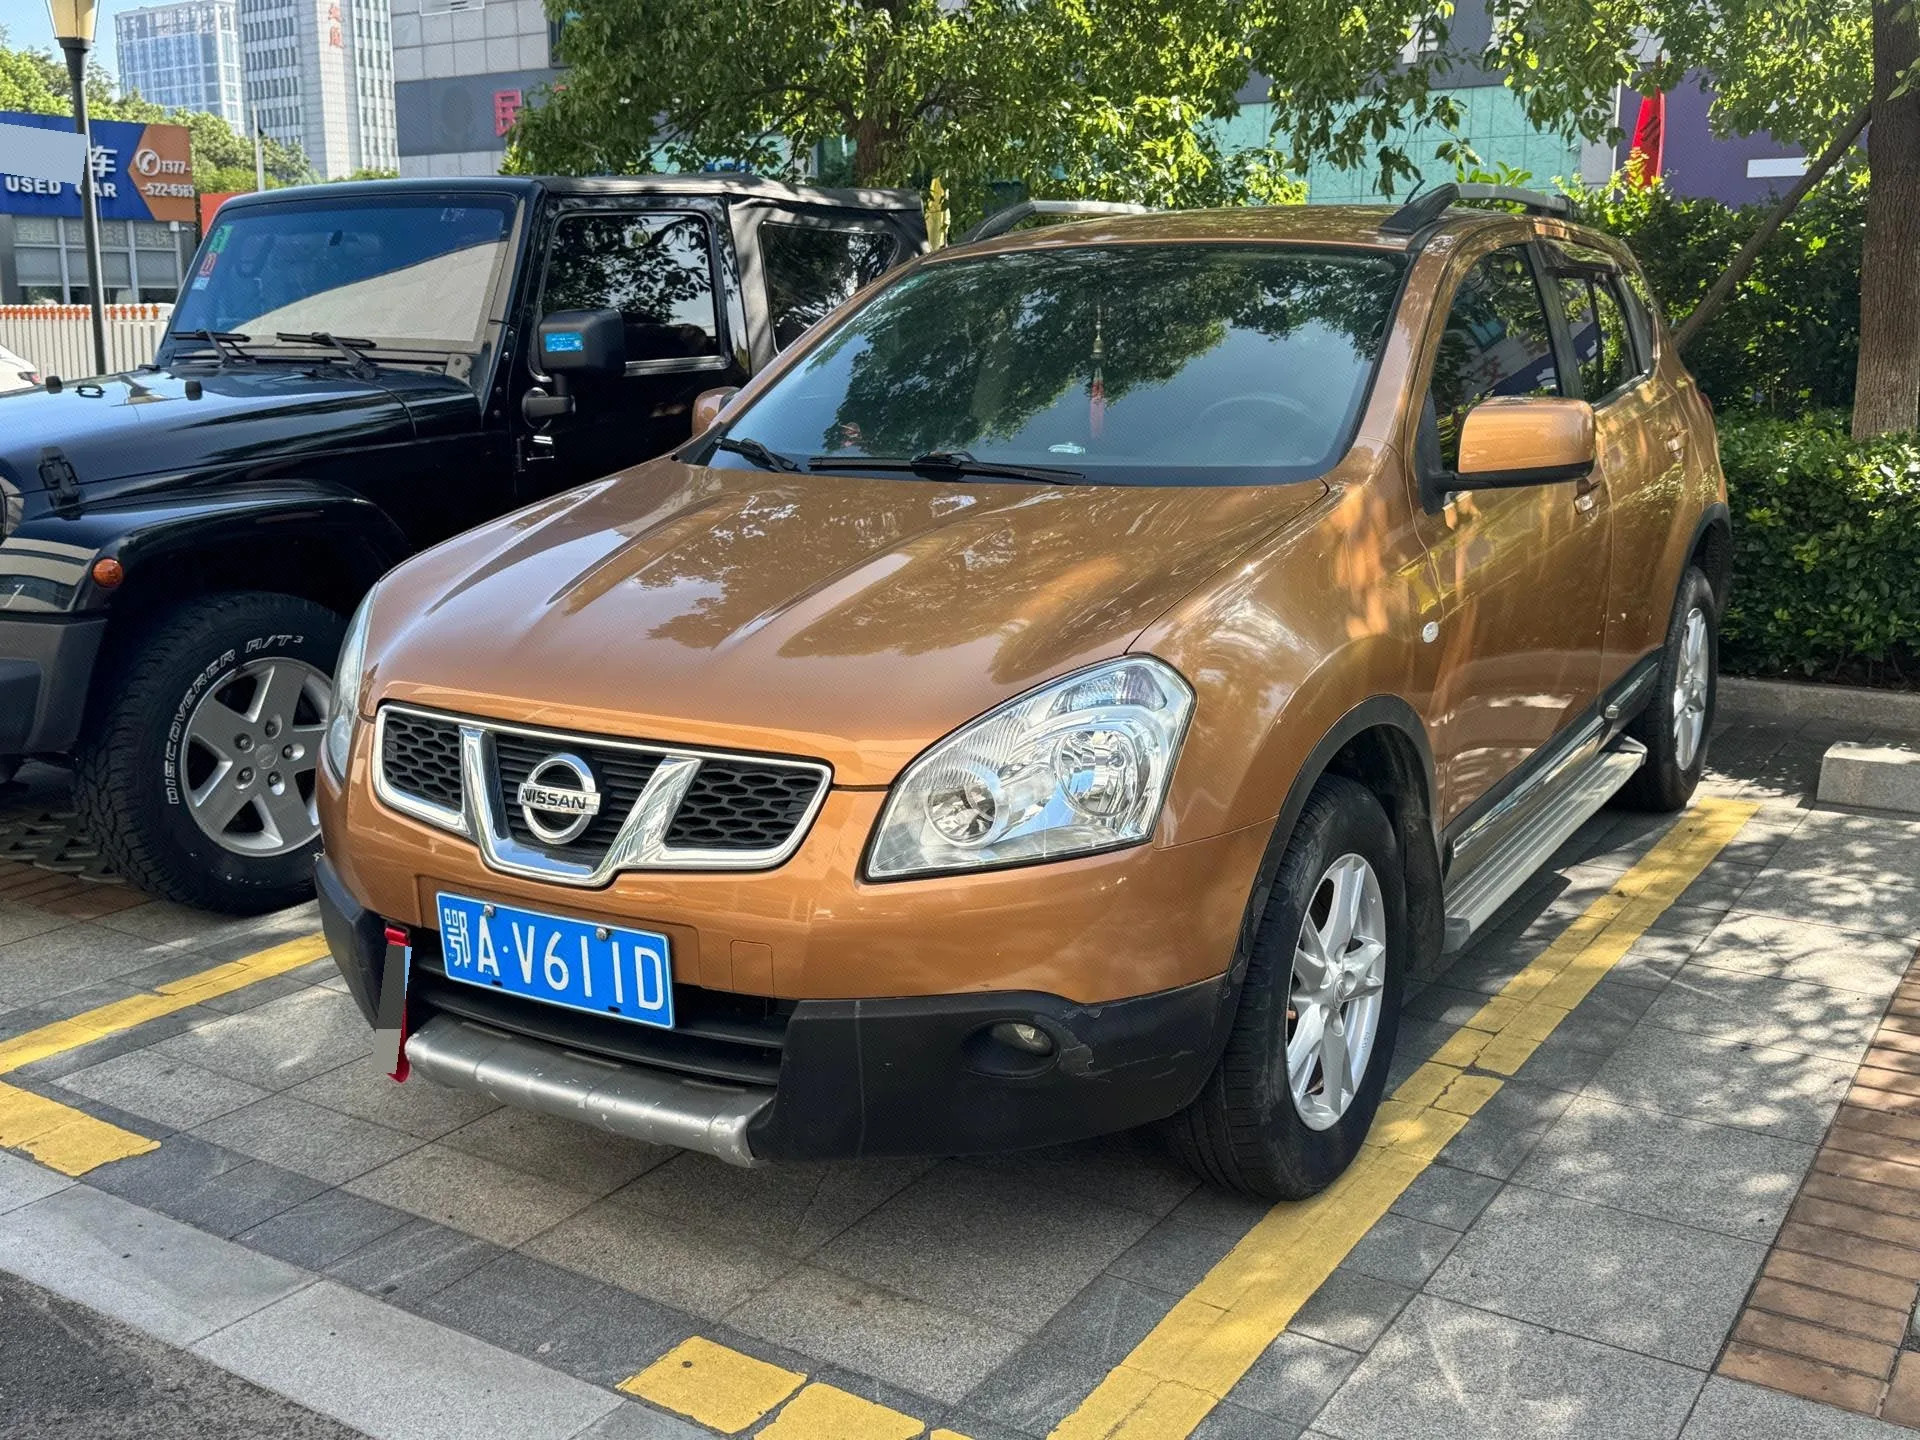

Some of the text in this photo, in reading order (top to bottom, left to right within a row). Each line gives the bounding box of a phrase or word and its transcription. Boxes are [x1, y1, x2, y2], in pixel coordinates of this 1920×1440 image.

[5, 176, 62, 195] USED
[164, 648, 236, 805] DISCOVERER
[522, 788, 587, 810] NISSAN
